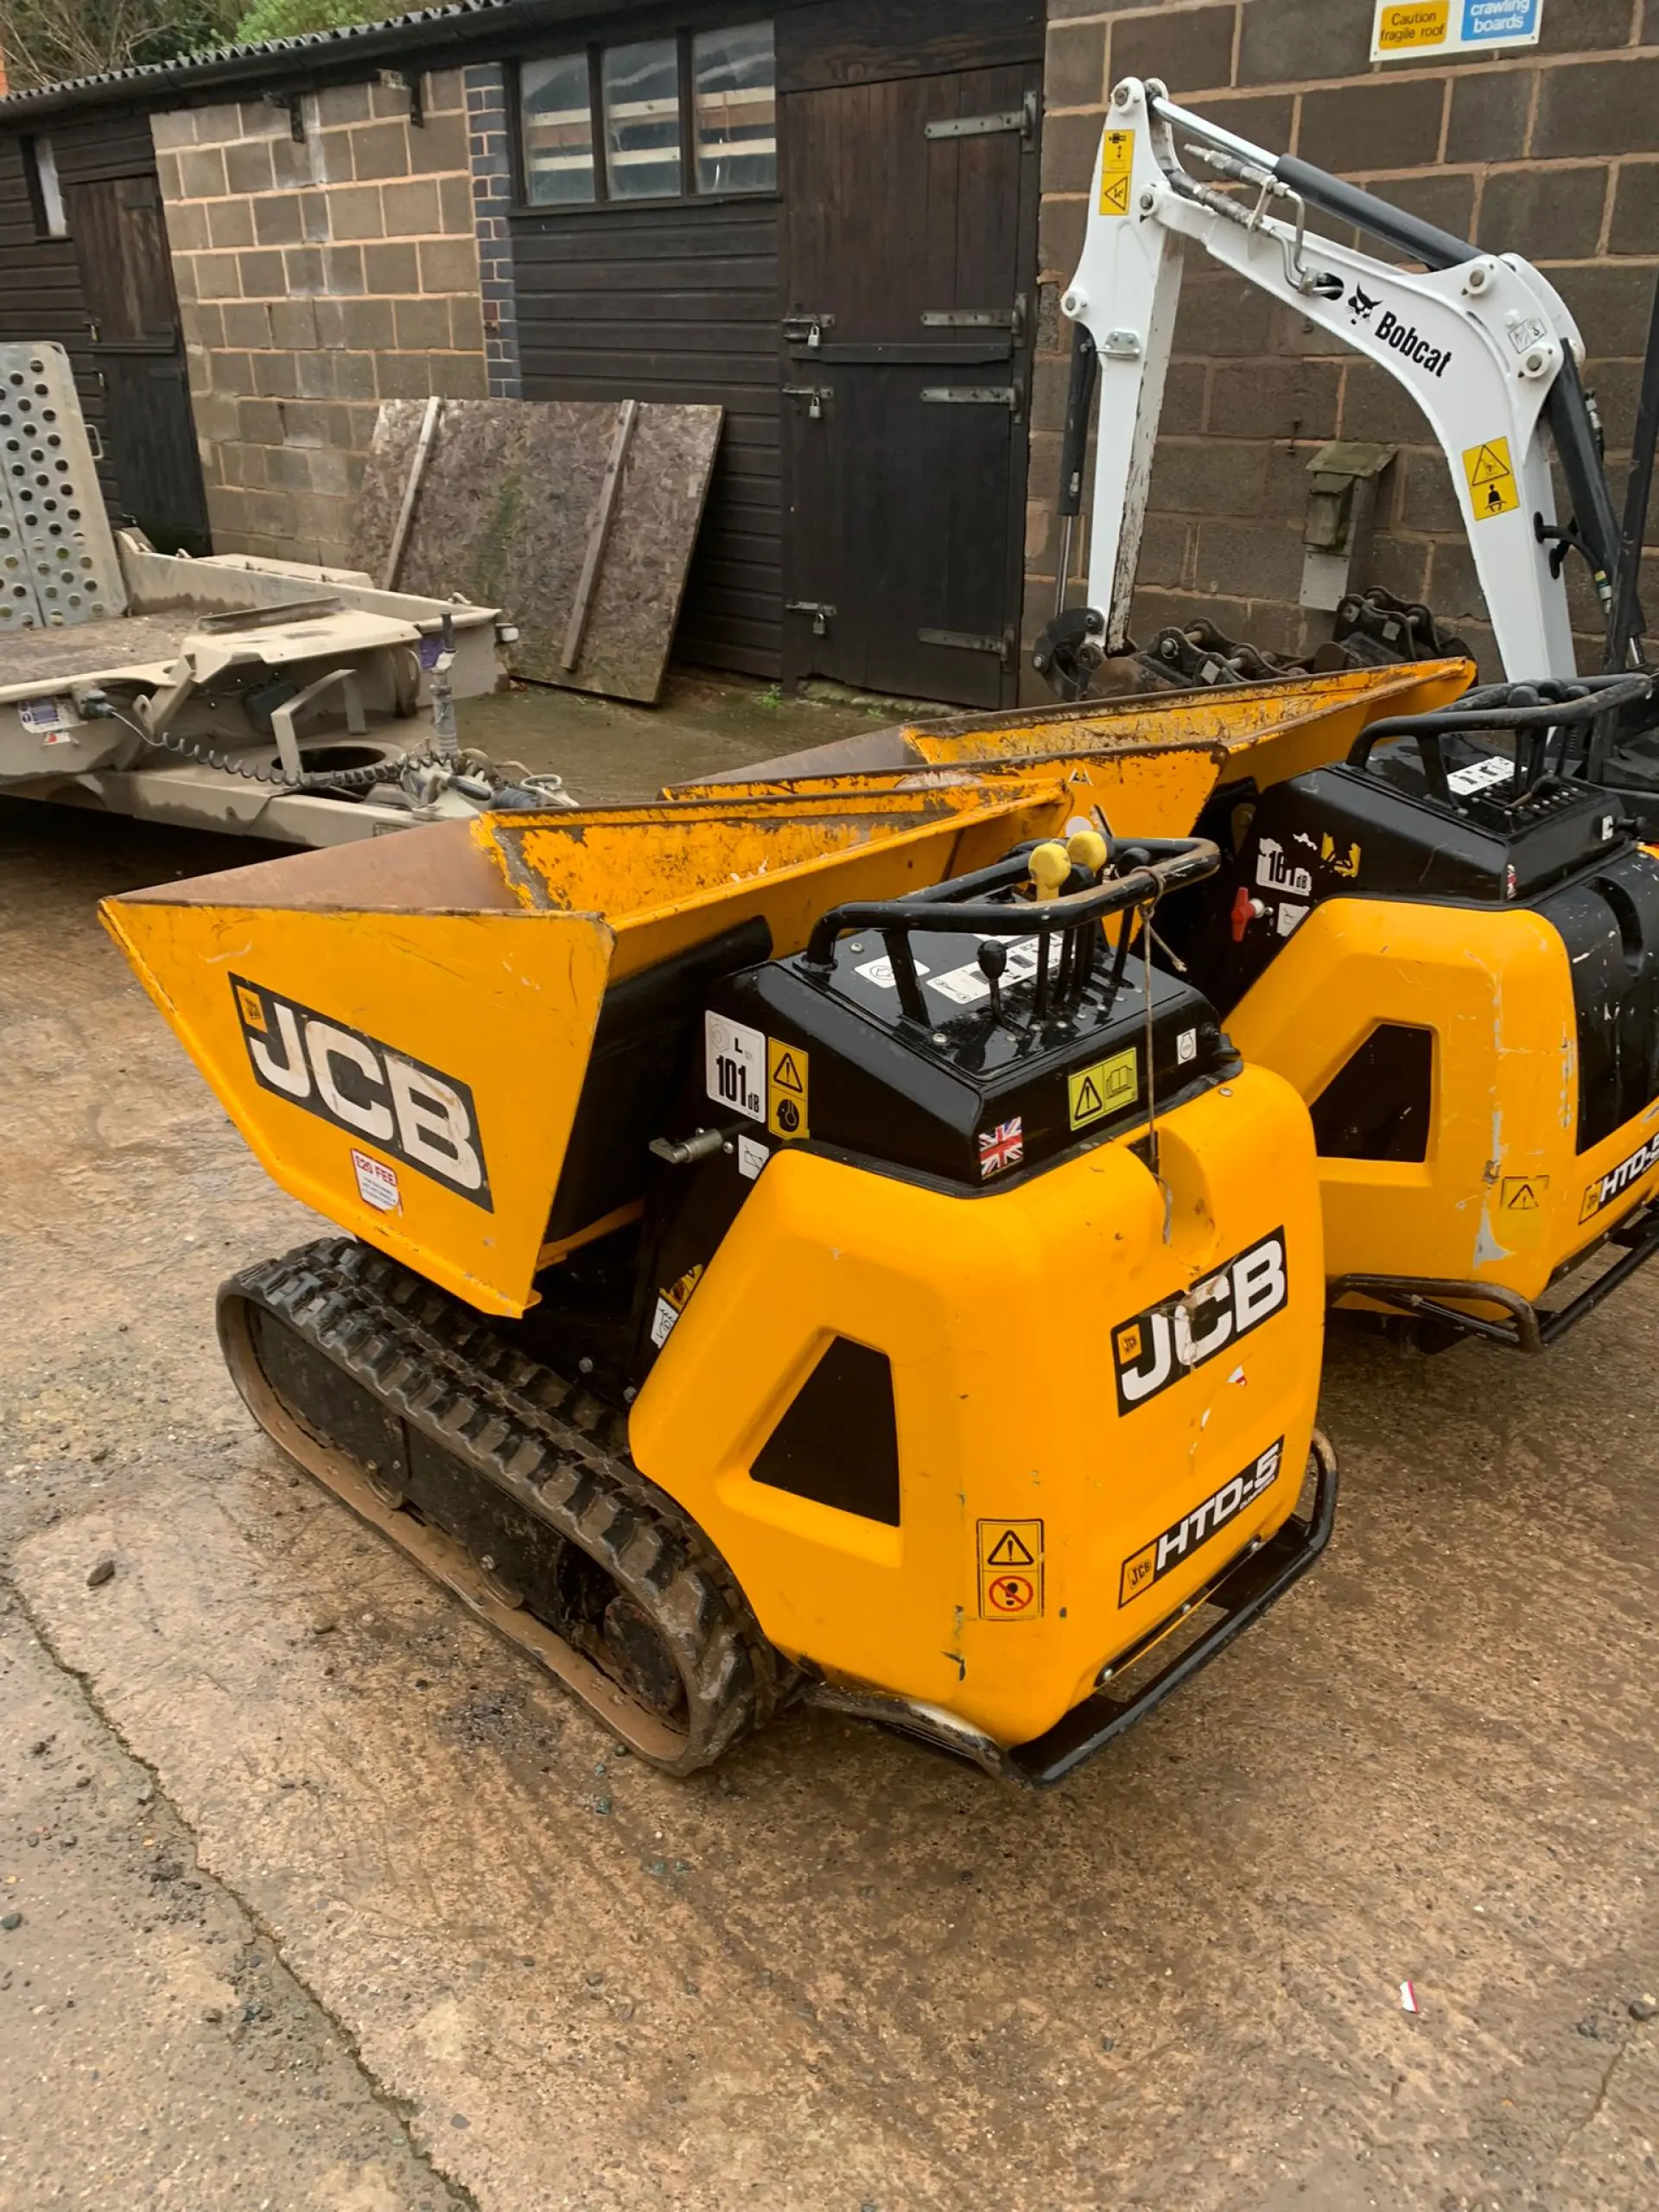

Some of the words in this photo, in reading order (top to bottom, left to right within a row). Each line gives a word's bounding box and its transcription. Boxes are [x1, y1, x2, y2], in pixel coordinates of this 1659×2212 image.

[1391, 11, 1437, 27] Caution
[1471, 0, 1529, 16] crawling
[1473, 14, 1524, 34] boards
[1380, 26, 1414, 42] fragile
[1421, 23, 1445, 37] roof
[1374, 310, 1452, 378] Bobcat
[734, 1037, 743, 1054] L
[249, 1001, 482, 1190] JCB
[715, 1054, 747, 1108] 101
[747, 1092, 760, 1114] dB
[1122, 1239, 1286, 1401] JCB
[1155, 1442, 1280, 1571] HTD-5
